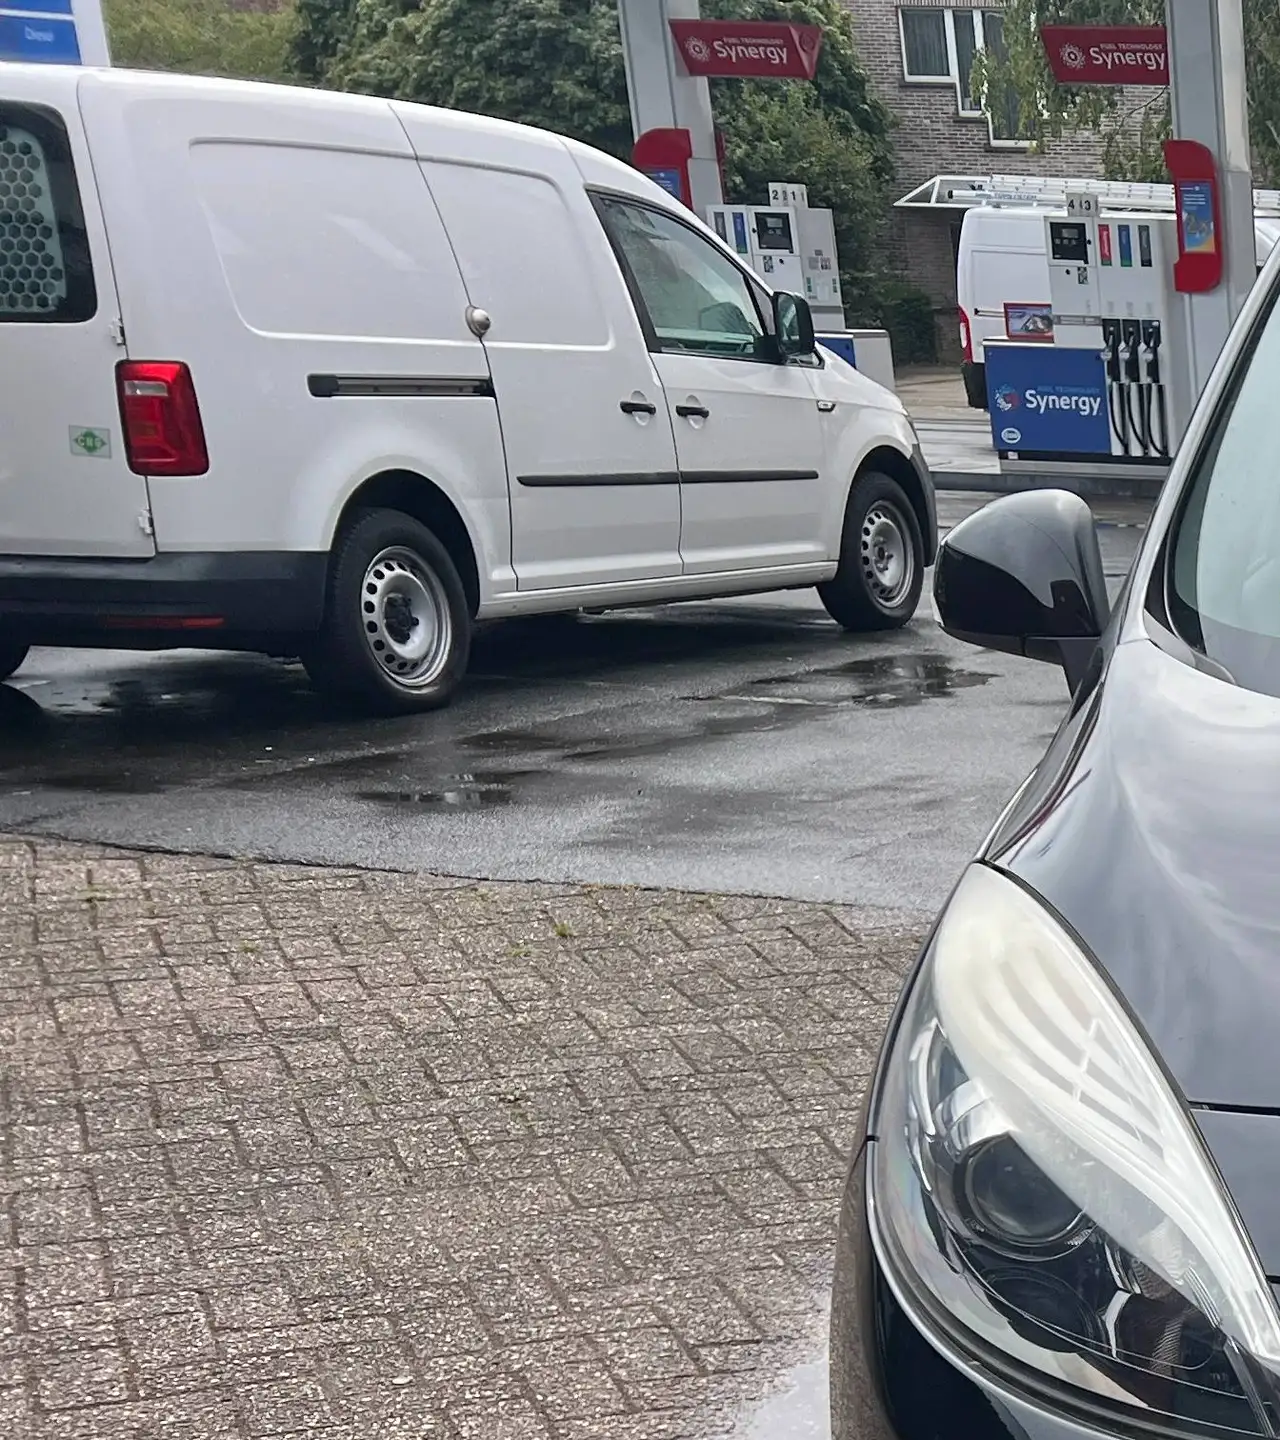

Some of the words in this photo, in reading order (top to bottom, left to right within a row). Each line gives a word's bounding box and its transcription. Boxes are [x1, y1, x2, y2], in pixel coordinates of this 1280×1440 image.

[713, 40, 788, 65] Synergy
[1089, 47, 1165, 70] Synergy
[771, 189, 779, 200] 2
[790, 191, 796, 200] 1
[1068, 199, 1075, 210] 4
[1084, 200, 1091, 211] 3
[1025, 389, 1101, 416] Synergy
